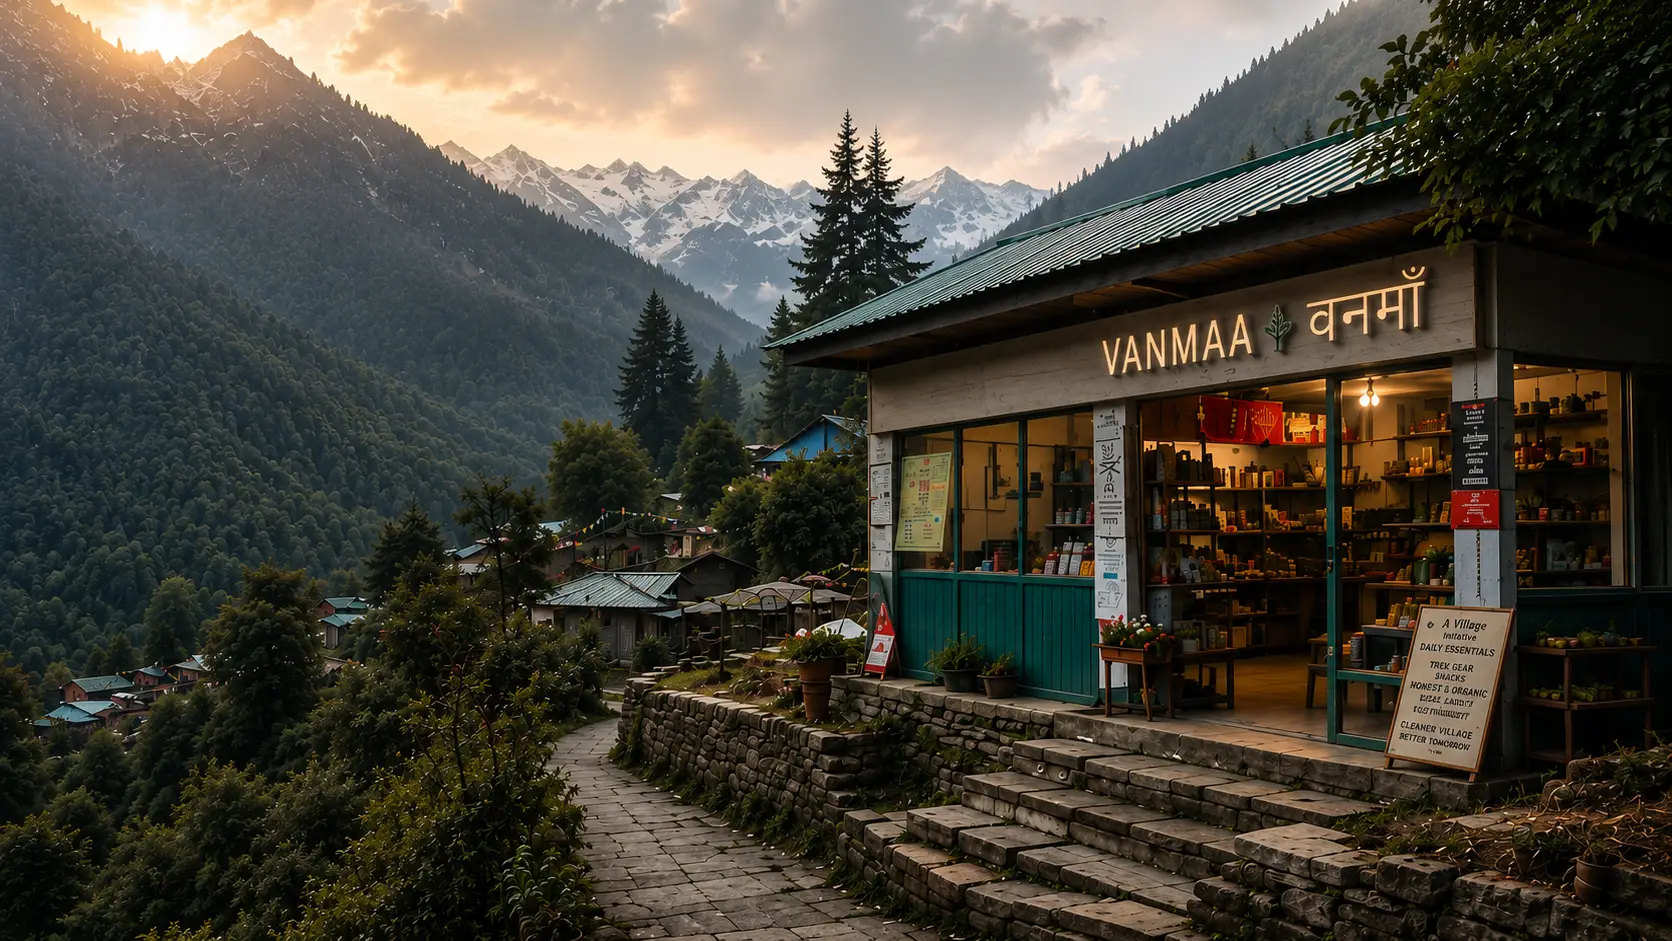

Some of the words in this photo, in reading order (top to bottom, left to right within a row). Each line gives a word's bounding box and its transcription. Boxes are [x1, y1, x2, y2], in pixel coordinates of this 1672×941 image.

[1102, 313, 1253, 376] VANMAA
[1441, 618, 1450, 629] A
[1454, 618, 1488, 632] Village
[1420, 642, 1443, 652] DAILY
[1444, 644, 1496, 657] ESSENTIALS
[1430, 660, 1450, 670] TREK
[1452, 663, 1474, 673] GEAR
[1434, 672, 1466, 683] SNACKS
[1410, 681, 1443, 692] HONEST
[1451, 686, 1488, 698] ORGANIC
[1400, 720, 1437, 733] CLEANER
[1439, 727, 1473, 740] VILLAGE
[1399, 732, 1427, 744] BETTER
